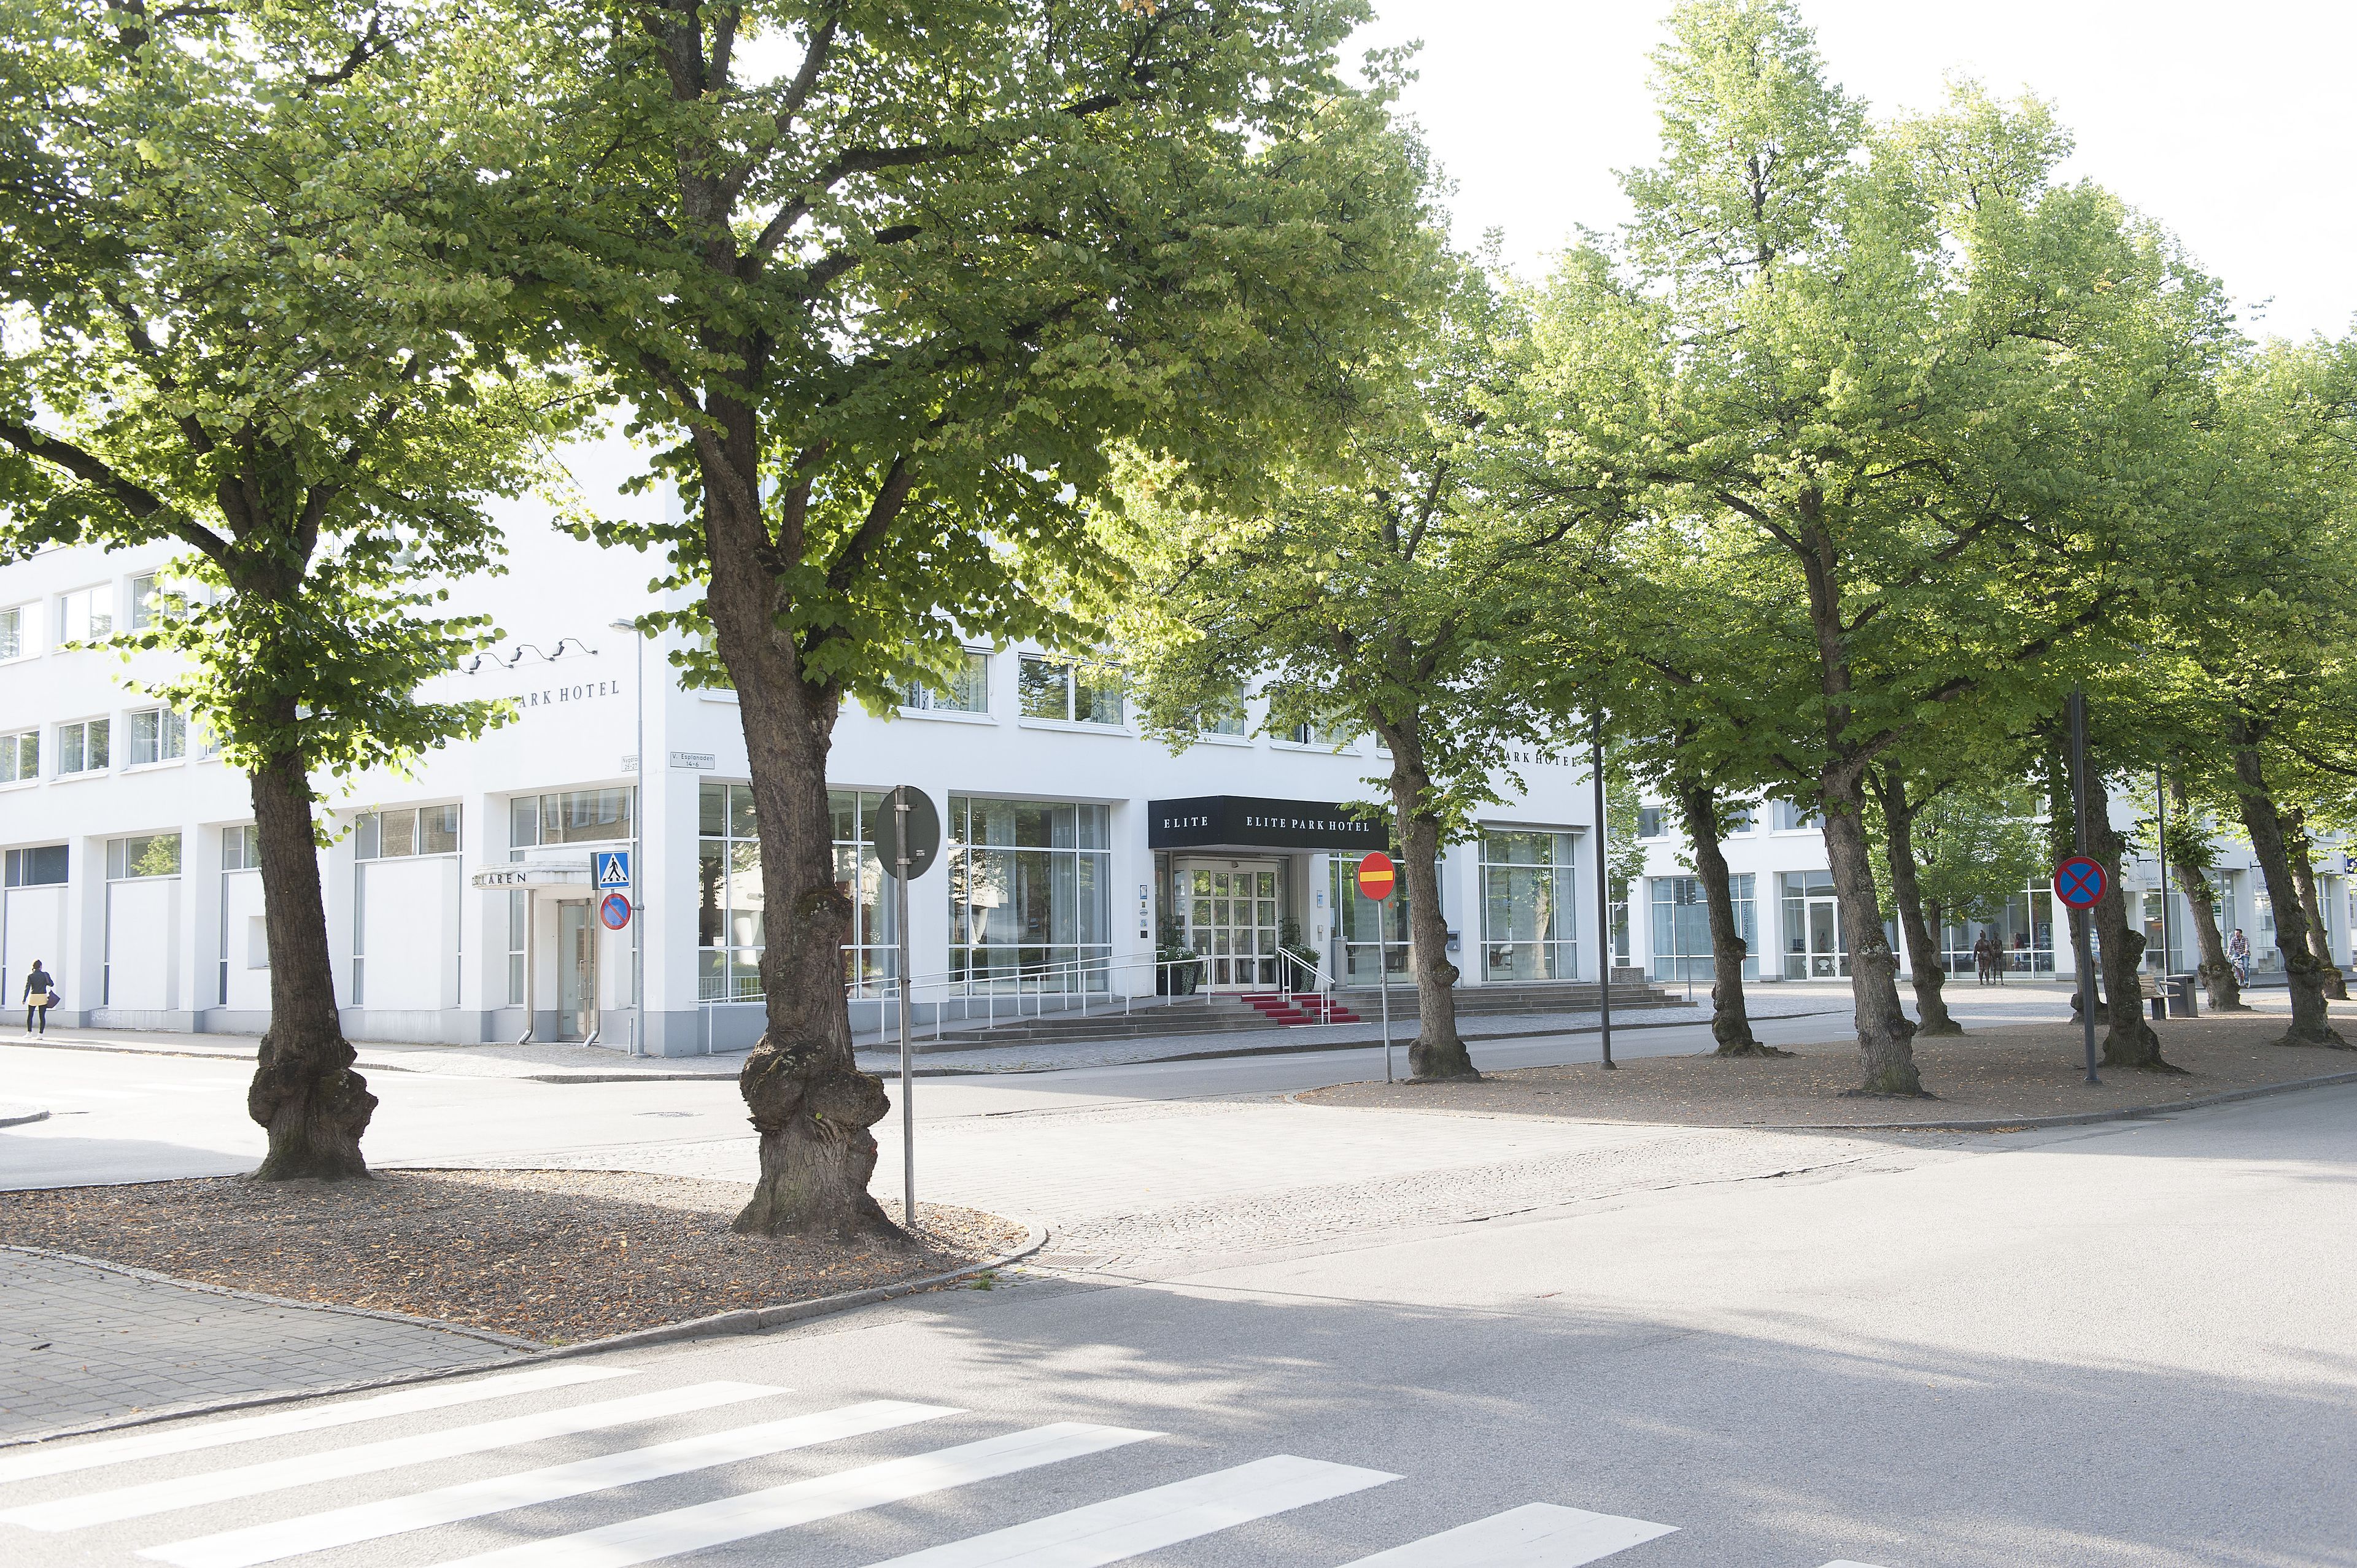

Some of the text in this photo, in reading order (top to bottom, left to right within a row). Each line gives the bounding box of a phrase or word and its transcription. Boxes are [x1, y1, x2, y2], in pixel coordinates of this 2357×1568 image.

[560, 680, 620, 702] HOTEL
[1497, 750, 1530, 763] ARK
[1535, 753, 1577, 767] HOTEL
[1163, 816, 1209, 828] ELITE
[1246, 816, 1370, 832] ELITE PARK HOTEL
